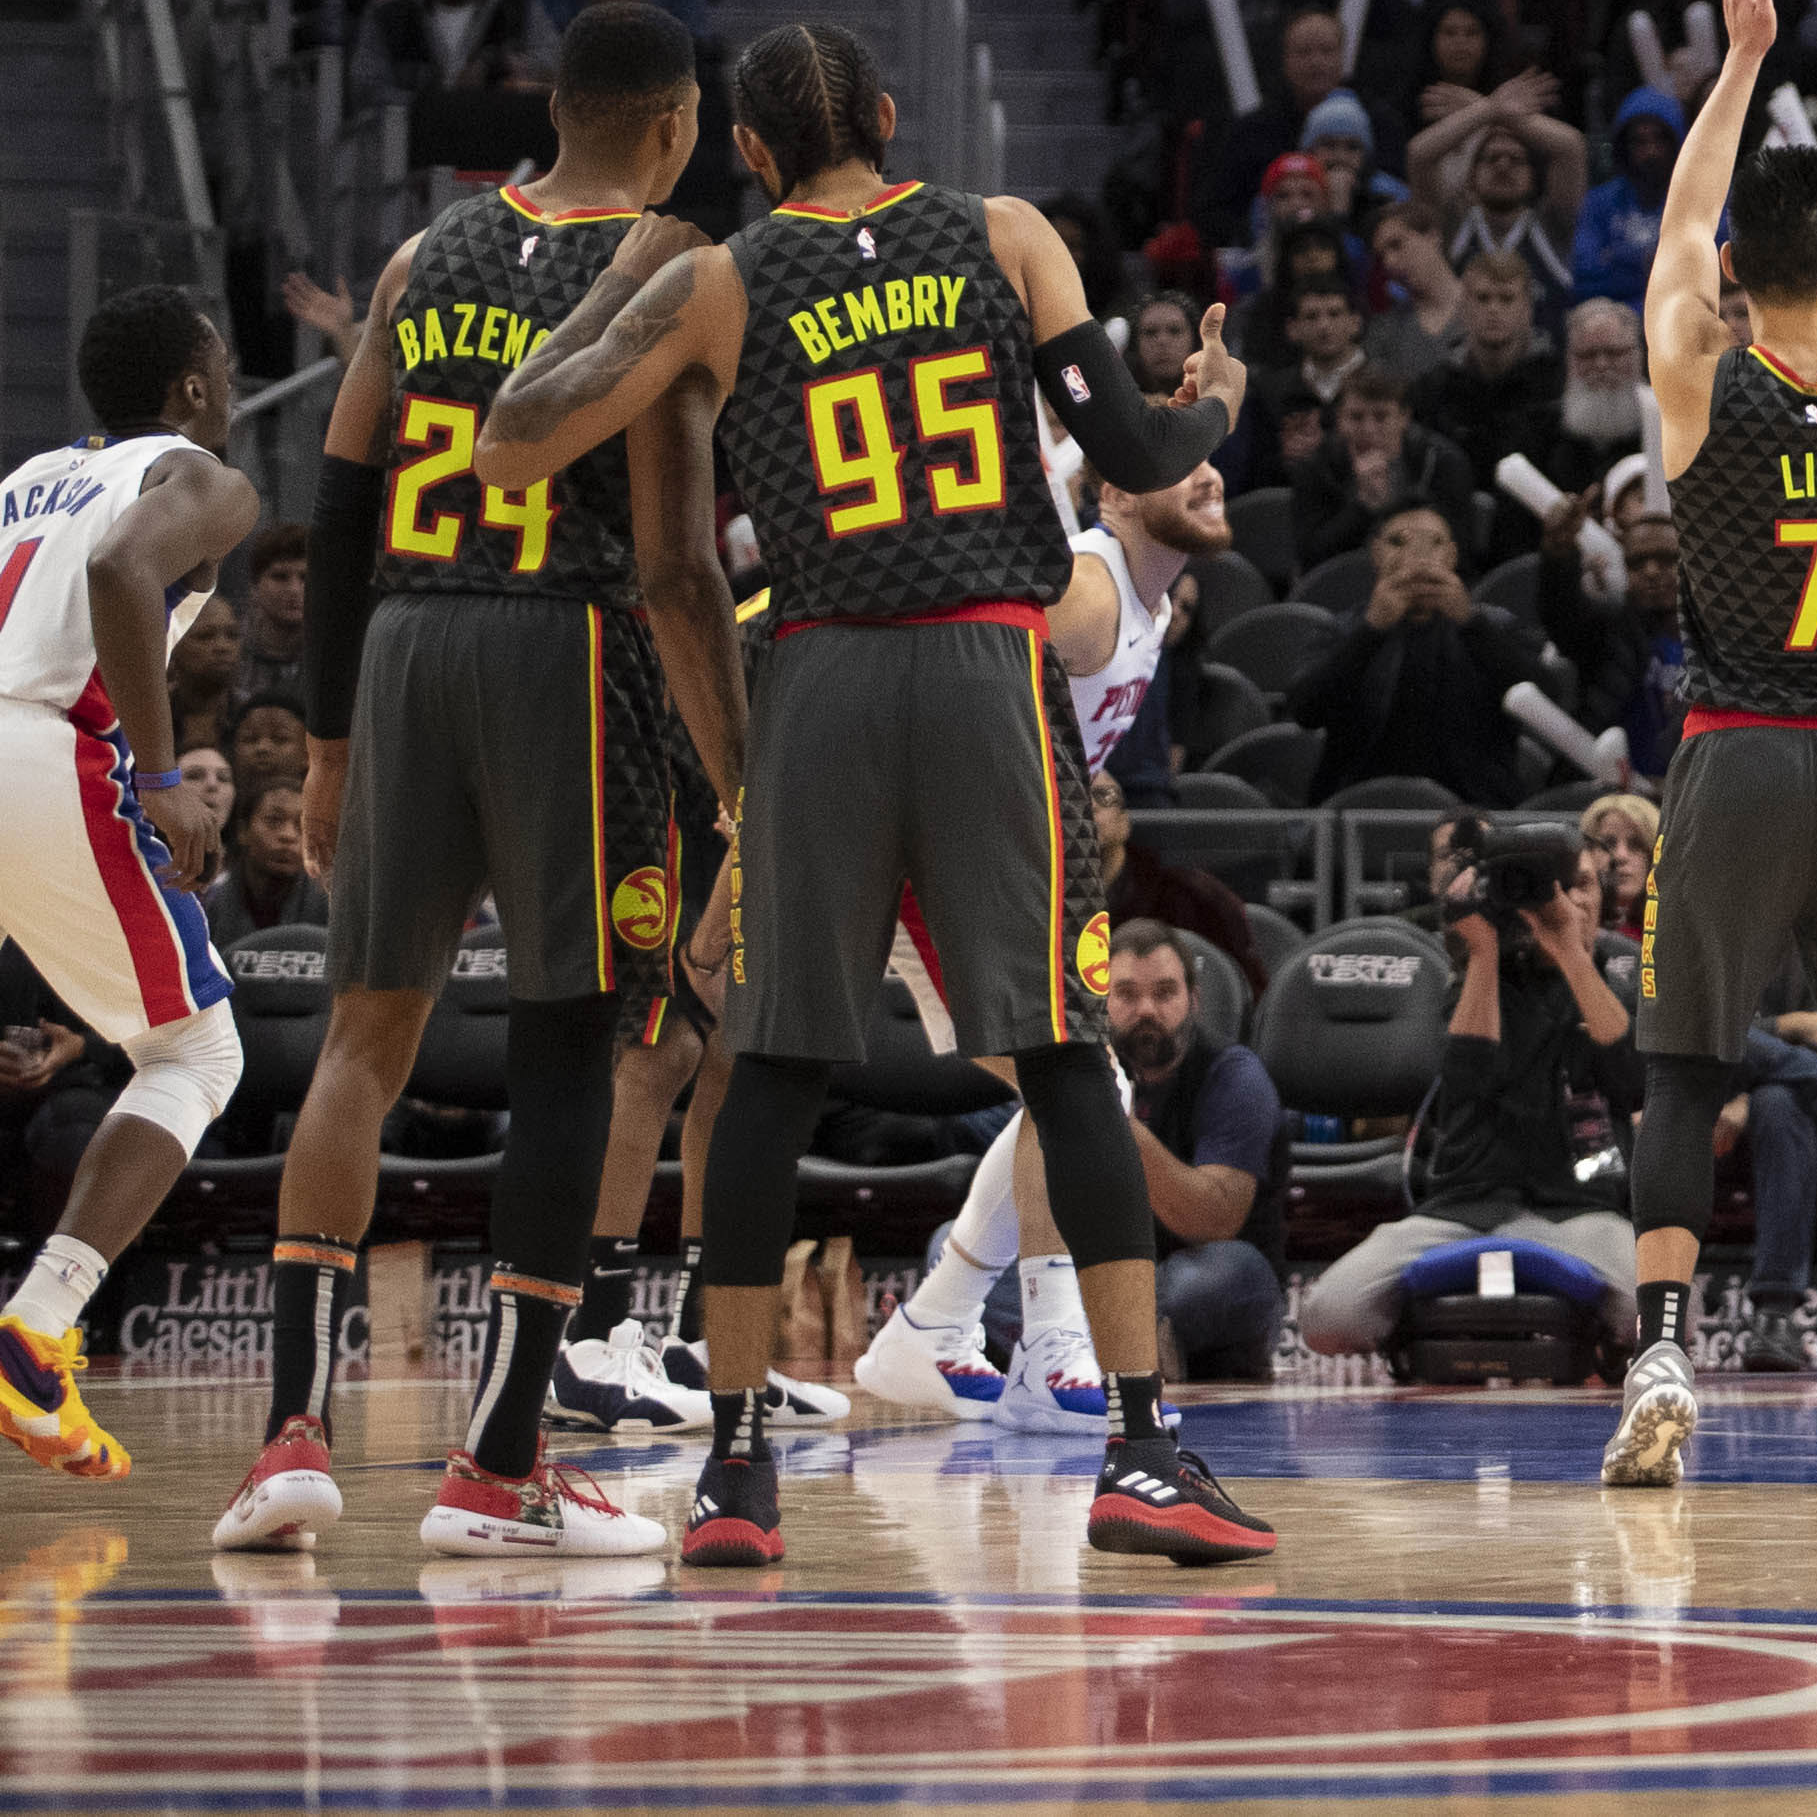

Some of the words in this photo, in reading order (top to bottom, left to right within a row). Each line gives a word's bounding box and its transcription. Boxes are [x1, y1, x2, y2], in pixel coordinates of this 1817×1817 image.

[788, 275, 967, 365] BEMBRY
[802, 345, 1005, 539] 95
[384, 392, 562, 575] 24
[1306, 954, 1422, 970] MEADE
[1312, 968, 1414, 987] LEXUS
[162, 1262, 275, 1314] Littl
